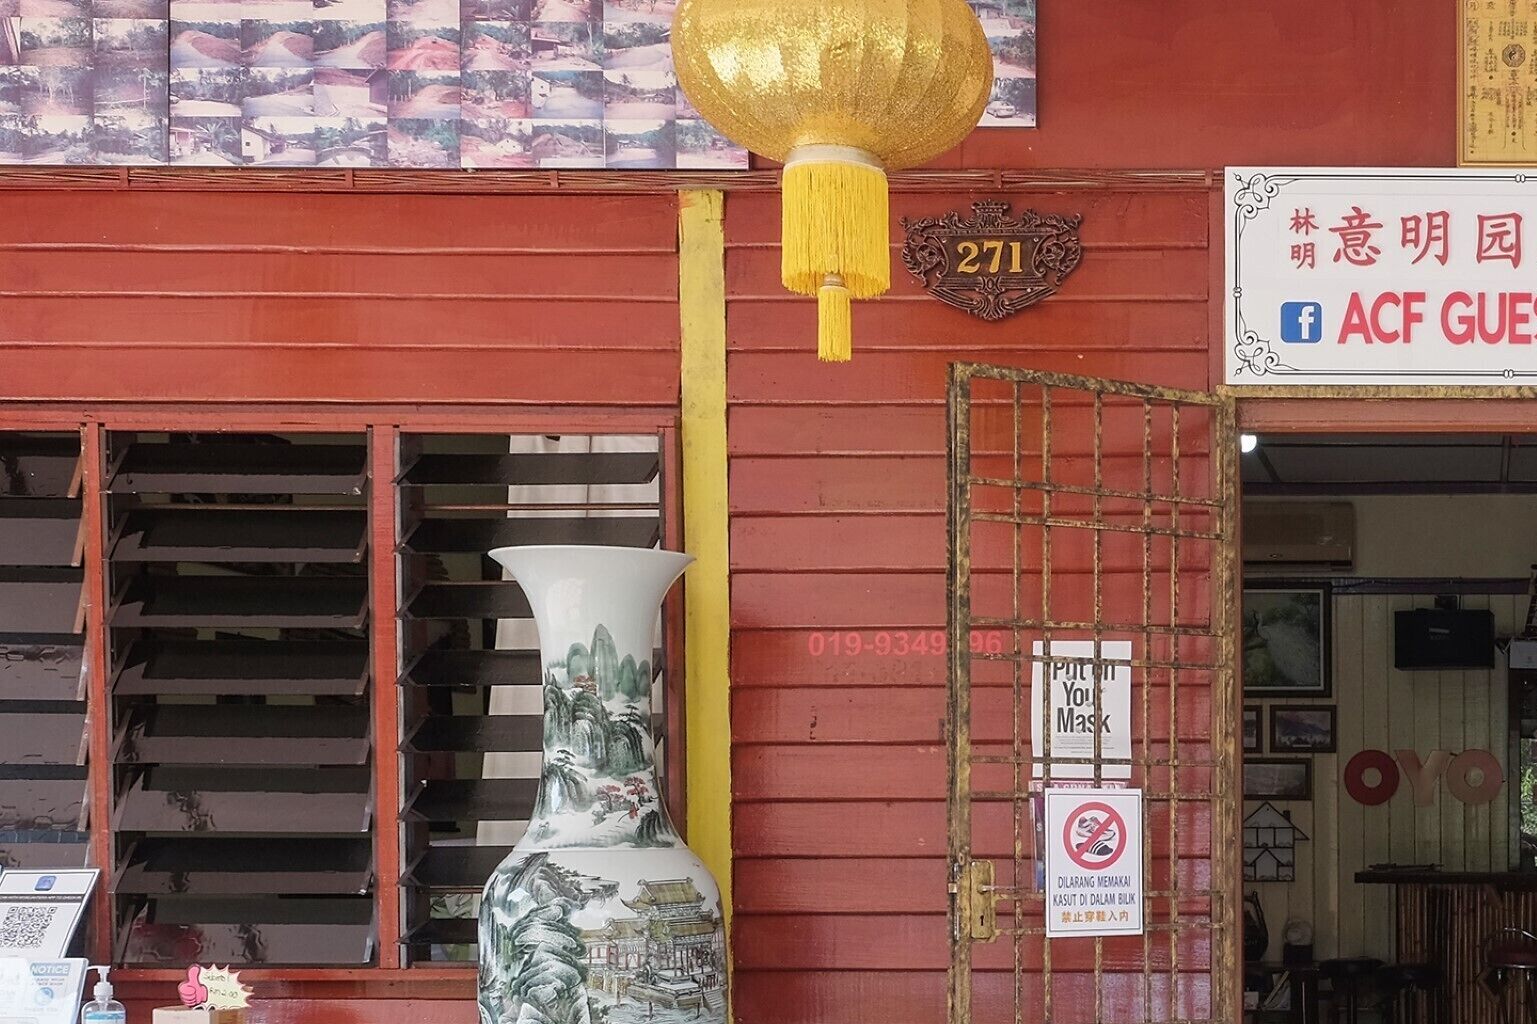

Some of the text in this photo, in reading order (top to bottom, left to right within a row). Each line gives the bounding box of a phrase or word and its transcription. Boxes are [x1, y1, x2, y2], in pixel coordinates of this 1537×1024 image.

[957, 241, 1023, 274] 271
[1337, 292, 1427, 345] ACF
[808, 631, 1002, 657] 019-934996
[1062, 681, 1107, 707] You
[1344, 748, 1503, 807] OYO
[1058, 875, 1131, 889] DILARANG MEMAKAI
[1053, 893, 1136, 906] KASUT DI DALAM BILIK
[1061, 910, 1129, 924] 禁止穿鞋入内
[31, 964, 69, 975] NOTICE
